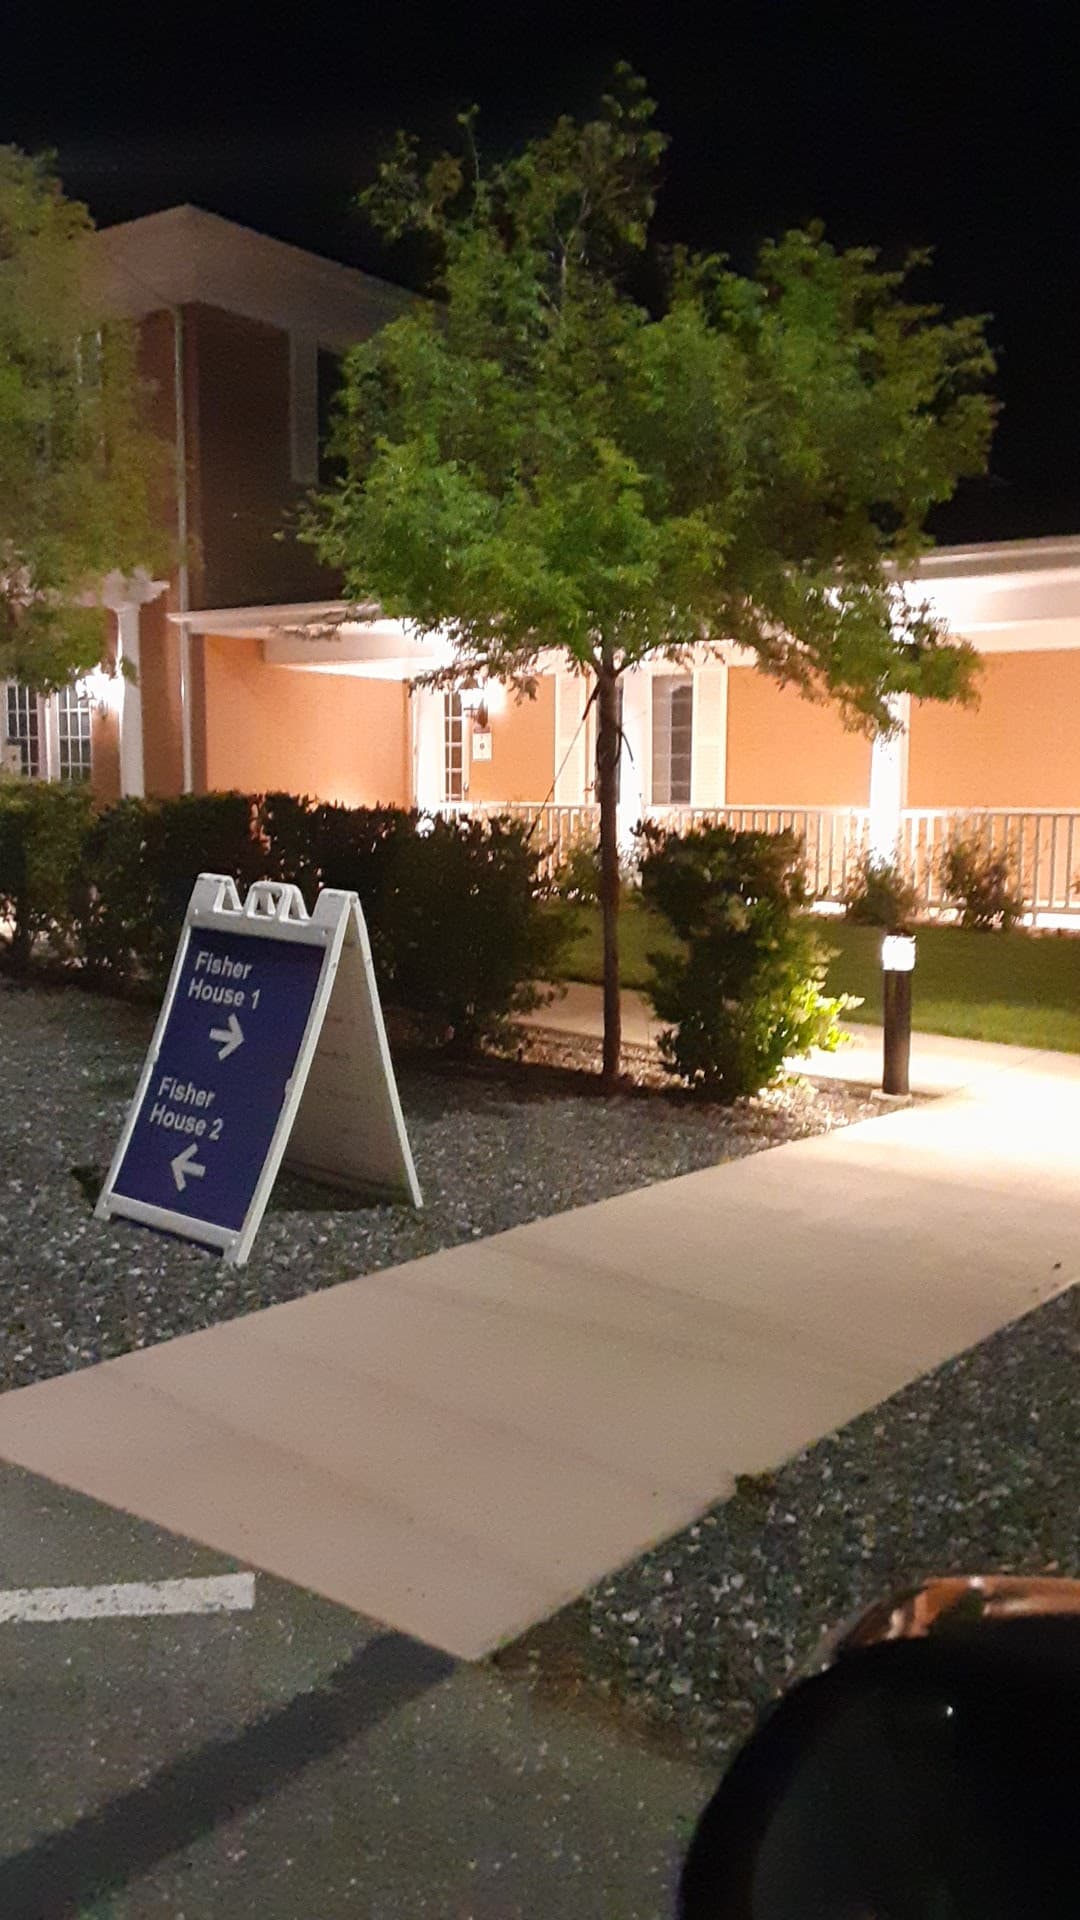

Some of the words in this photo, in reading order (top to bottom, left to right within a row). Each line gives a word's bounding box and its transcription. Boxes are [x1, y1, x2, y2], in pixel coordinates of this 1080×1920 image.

[194, 951, 252, 980] Fisher
[188, 977, 245, 1007] House
[250, 988, 261, 1010] 1
[158, 1077, 215, 1108] Fisher
[149, 1106, 206, 1137] House
[208, 1118, 224, 1141] 2
